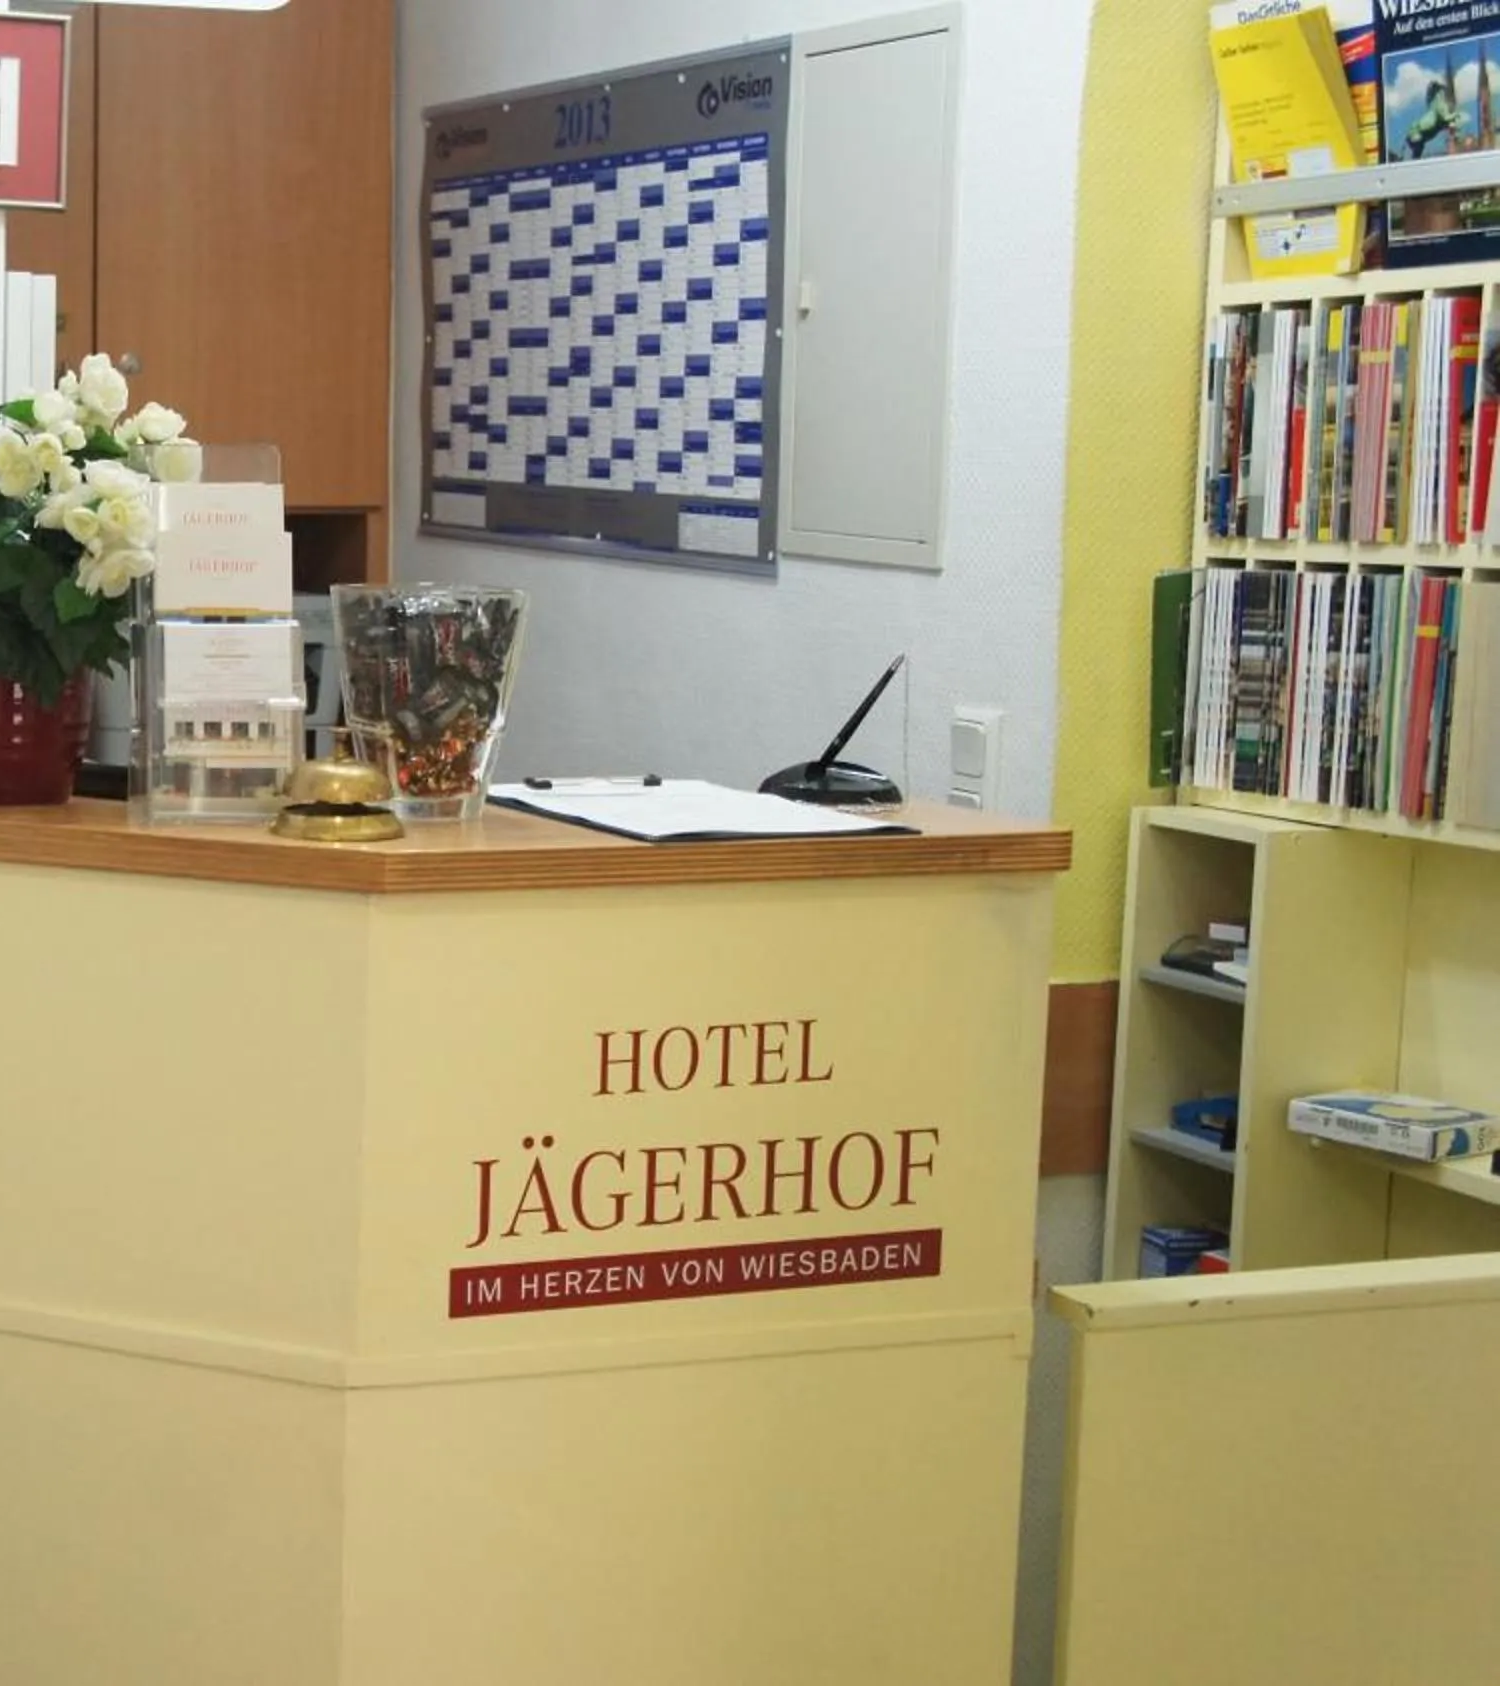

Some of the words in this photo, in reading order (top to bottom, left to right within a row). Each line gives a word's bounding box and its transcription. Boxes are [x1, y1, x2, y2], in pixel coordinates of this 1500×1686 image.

[1378, 0, 1472, 19] WIESB
[1393, 18, 1414, 35] Auf
[1415, 14, 1435, 31] den
[720, 73, 773, 104] Vision
[554, 96, 612, 149] 2013
[592, 1019, 834, 1096] HOTEL
[465, 1127, 941, 1249] JÄGERHOF
[466, 1276, 501, 1305] IM
[520, 1266, 645, 1300] HERZEN
[661, 1258, 724, 1287] VON
[740, 1242, 922, 1282] WIESBADEN
